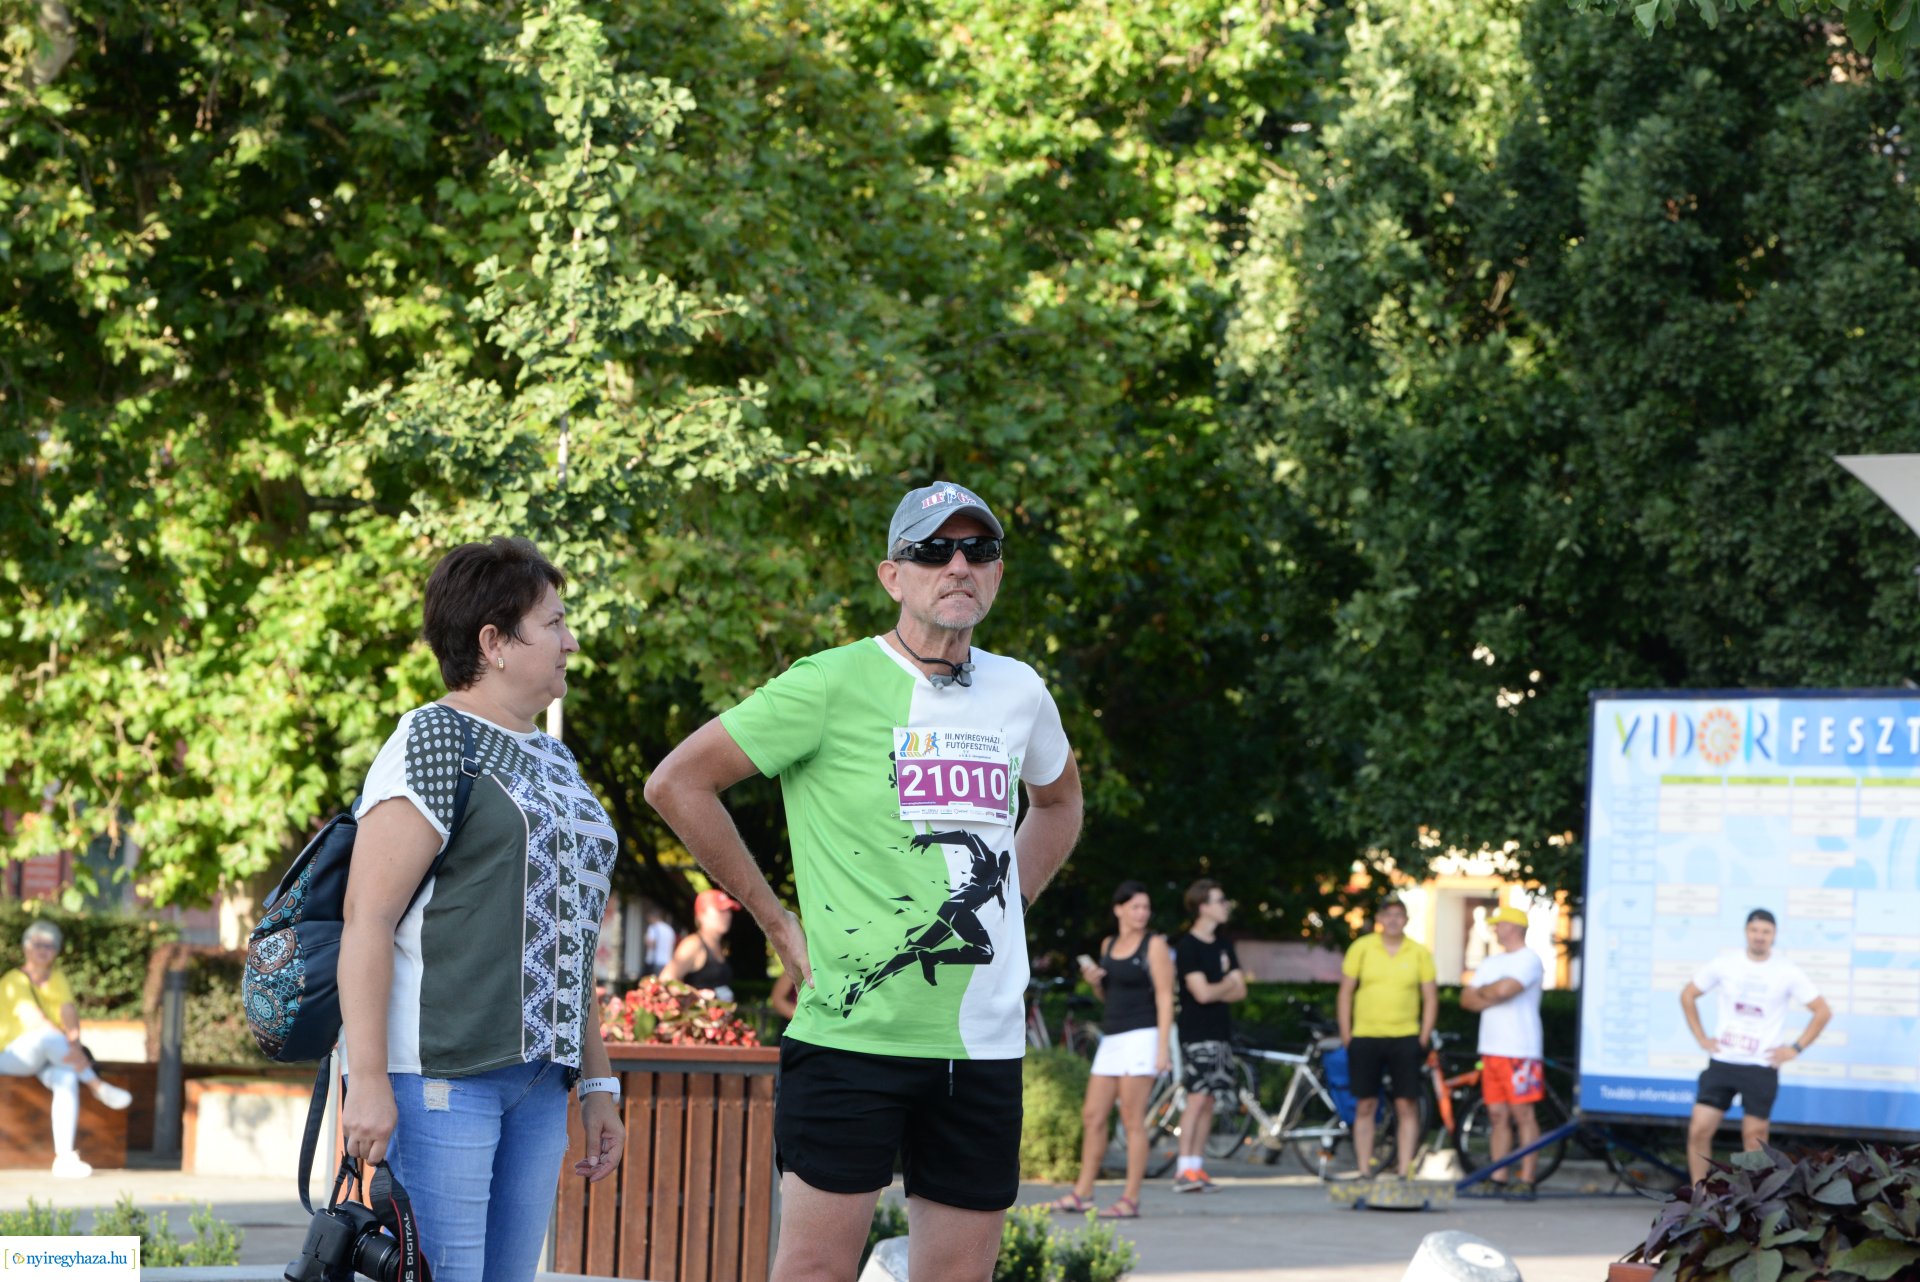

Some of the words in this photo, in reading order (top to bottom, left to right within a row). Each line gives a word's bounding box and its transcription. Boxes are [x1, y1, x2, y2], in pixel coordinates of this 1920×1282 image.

[945, 741, 1000, 753] FUTÓFESZTIVÁL
[1614, 702, 1771, 766] VIDOR
[901, 764, 1006, 801] 21010
[403, 1212, 414, 1266] DIGITAL
